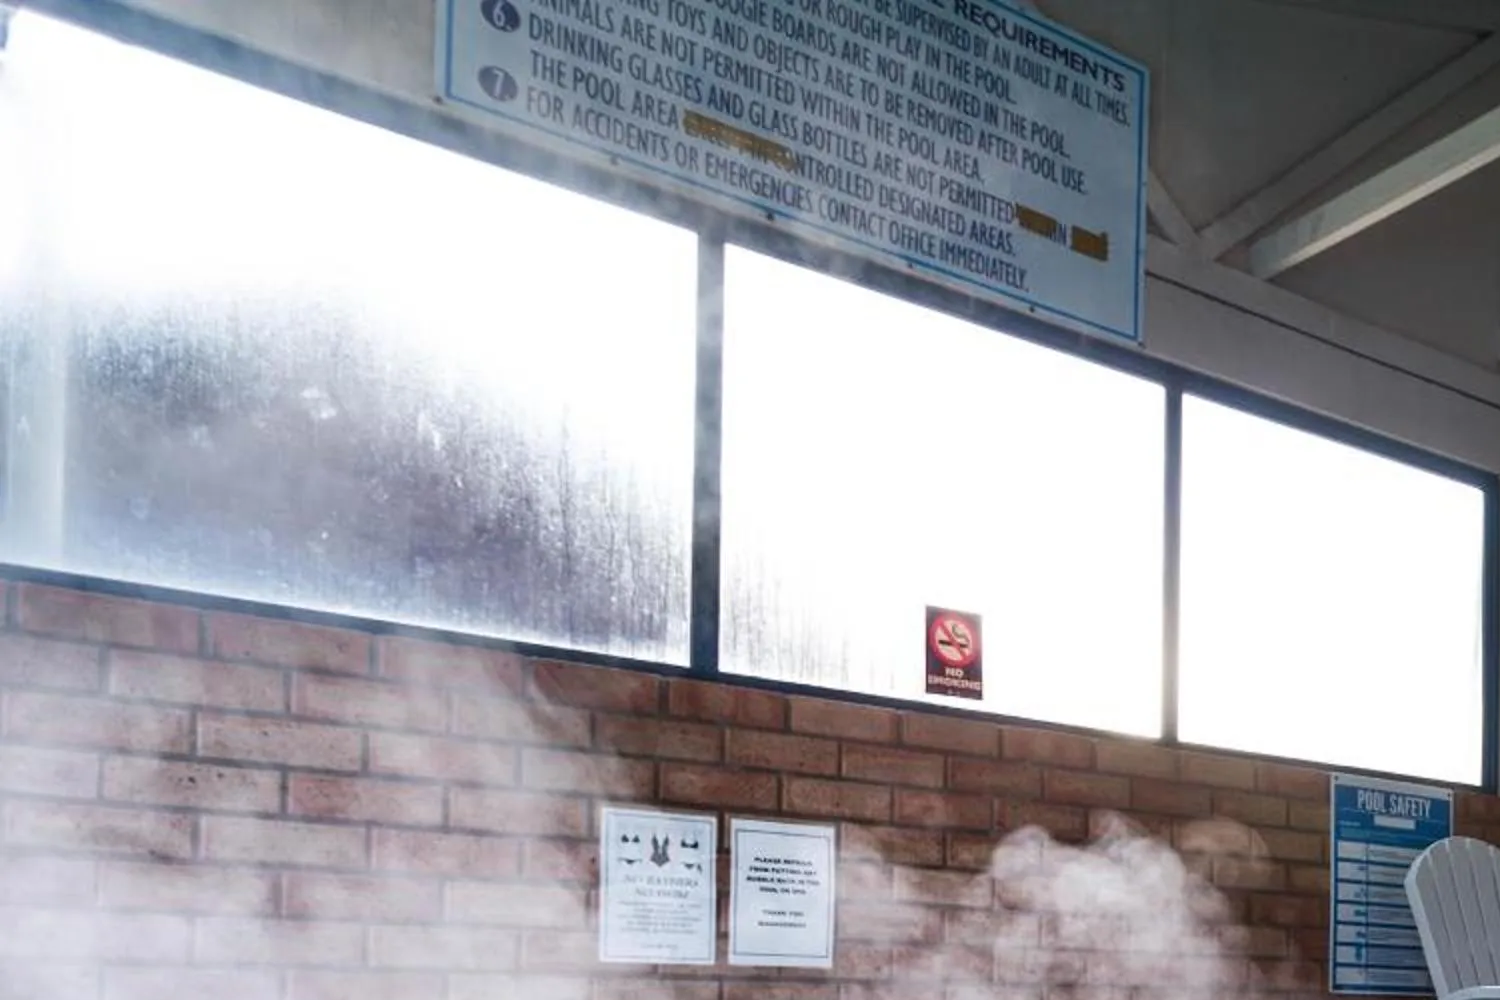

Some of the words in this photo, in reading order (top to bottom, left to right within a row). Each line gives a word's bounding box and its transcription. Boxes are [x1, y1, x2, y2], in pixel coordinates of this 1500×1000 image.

[620, 14, 656, 51] ARE
[660, 30, 699, 67] NOT
[703, 46, 795, 105] PERMITTED
[801, 86, 860, 132] WITHIN
[866, 113, 895, 146] THE
[899, 127, 940, 165] POOL
[666, 0, 706, 35] TOYS
[712, 16, 749, 51] AND
[752, 33, 819, 83] OBJECTS
[823, 65, 855, 98] ARE
[859, 78, 880, 107] TO
[884, 89, 903, 118] BE
[907, 99, 973, 146] REMOVED
[978, 129, 1018, 166] AFTER
[1022, 147, 1058, 184] POOL
[772, 7, 836, 57] BOARDS
[841, 40, 872, 72] ARE
[876, 53, 905, 87] NOT
[911, 70, 981, 118] ALLOWED
[984, 101, 999, 127] IN
[1003, 108, 1027, 140] THE
[826, 3, 882, 44] ROUGH
[885, 26, 921, 61] PLAY
[925, 43, 941, 70] IN
[946, 53, 971, 84] THE
[896, 2, 971, 52] SUPERVISED
[973, 34, 989, 60] BY
[993, 44, 1010, 70] AN
[1013, 55, 1050, 90] ADULT
[1054, 73, 1069, 98] AT
[1072, 78, 1092, 110] ALL
[954, 0, 1126, 92] REQUIREMENTS
[526, 85, 565, 125] FOR
[572, 104, 670, 162] ACCIDENTS
[674, 140, 700, 173] OR
[705, 152, 813, 213] EMERGENCIES
[818, 195, 886, 240] CONTACT
[889, 220, 937, 259] OFFICE
[528, 12, 623, 74] DRINKING
[628, 53, 703, 104] GLASSES
[707, 84, 745, 119] AND
[750, 101, 798, 140] GLASS
[802, 121, 868, 168] BOTTLES
[873, 151, 902, 181] ARE
[906, 164, 936, 197] NOT
[939, 176, 1014, 224] PERMITTED
[530, 50, 569, 89] THE
[572, 66, 625, 111] POOL
[630, 90, 680, 130] AREA
[878, 184, 966, 236] DESIGNATED
[1357, 789, 1387, 813] POOL
[1389, 793, 1431, 819] SAFETY
